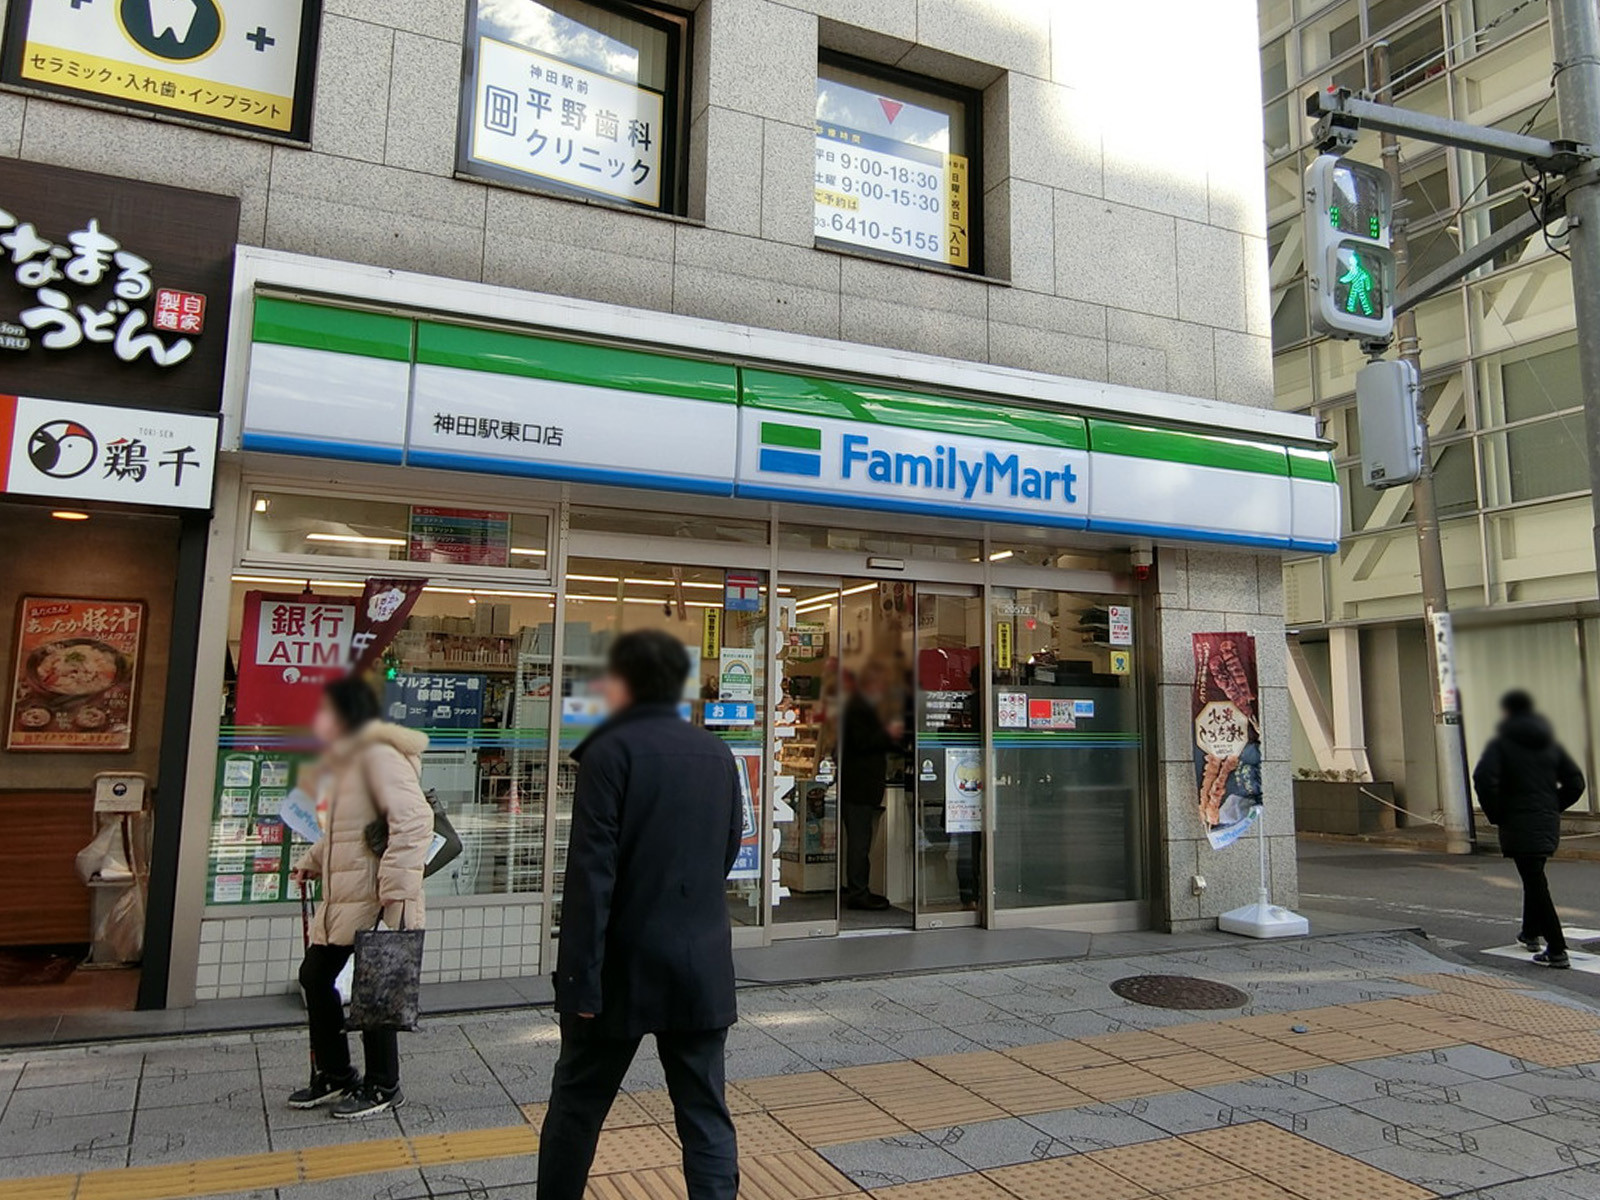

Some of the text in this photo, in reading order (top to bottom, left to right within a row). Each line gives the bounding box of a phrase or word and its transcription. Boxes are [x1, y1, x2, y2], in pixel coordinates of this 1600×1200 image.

[31, 54, 281, 119] セラミック・入れ歯・インプラント
[531, 64, 589, 95] 神田駅前
[526, 87, 652, 152] 平野歯科
[526, 128, 651, 186] クリニック
[841, 153, 938, 190] 9:00-18:30
[841, 176, 940, 213] 9:00-15:30
[0, 209, 152, 299] なまる
[950, 232, 961, 257] 入口
[20, 287, 193, 367] うどん
[433, 412, 564, 447] 神田駅東口店
[841, 433, 1077, 503] FamilyMart
[271, 604, 344, 638] 銀行
[268, 641, 340, 664] ATM
